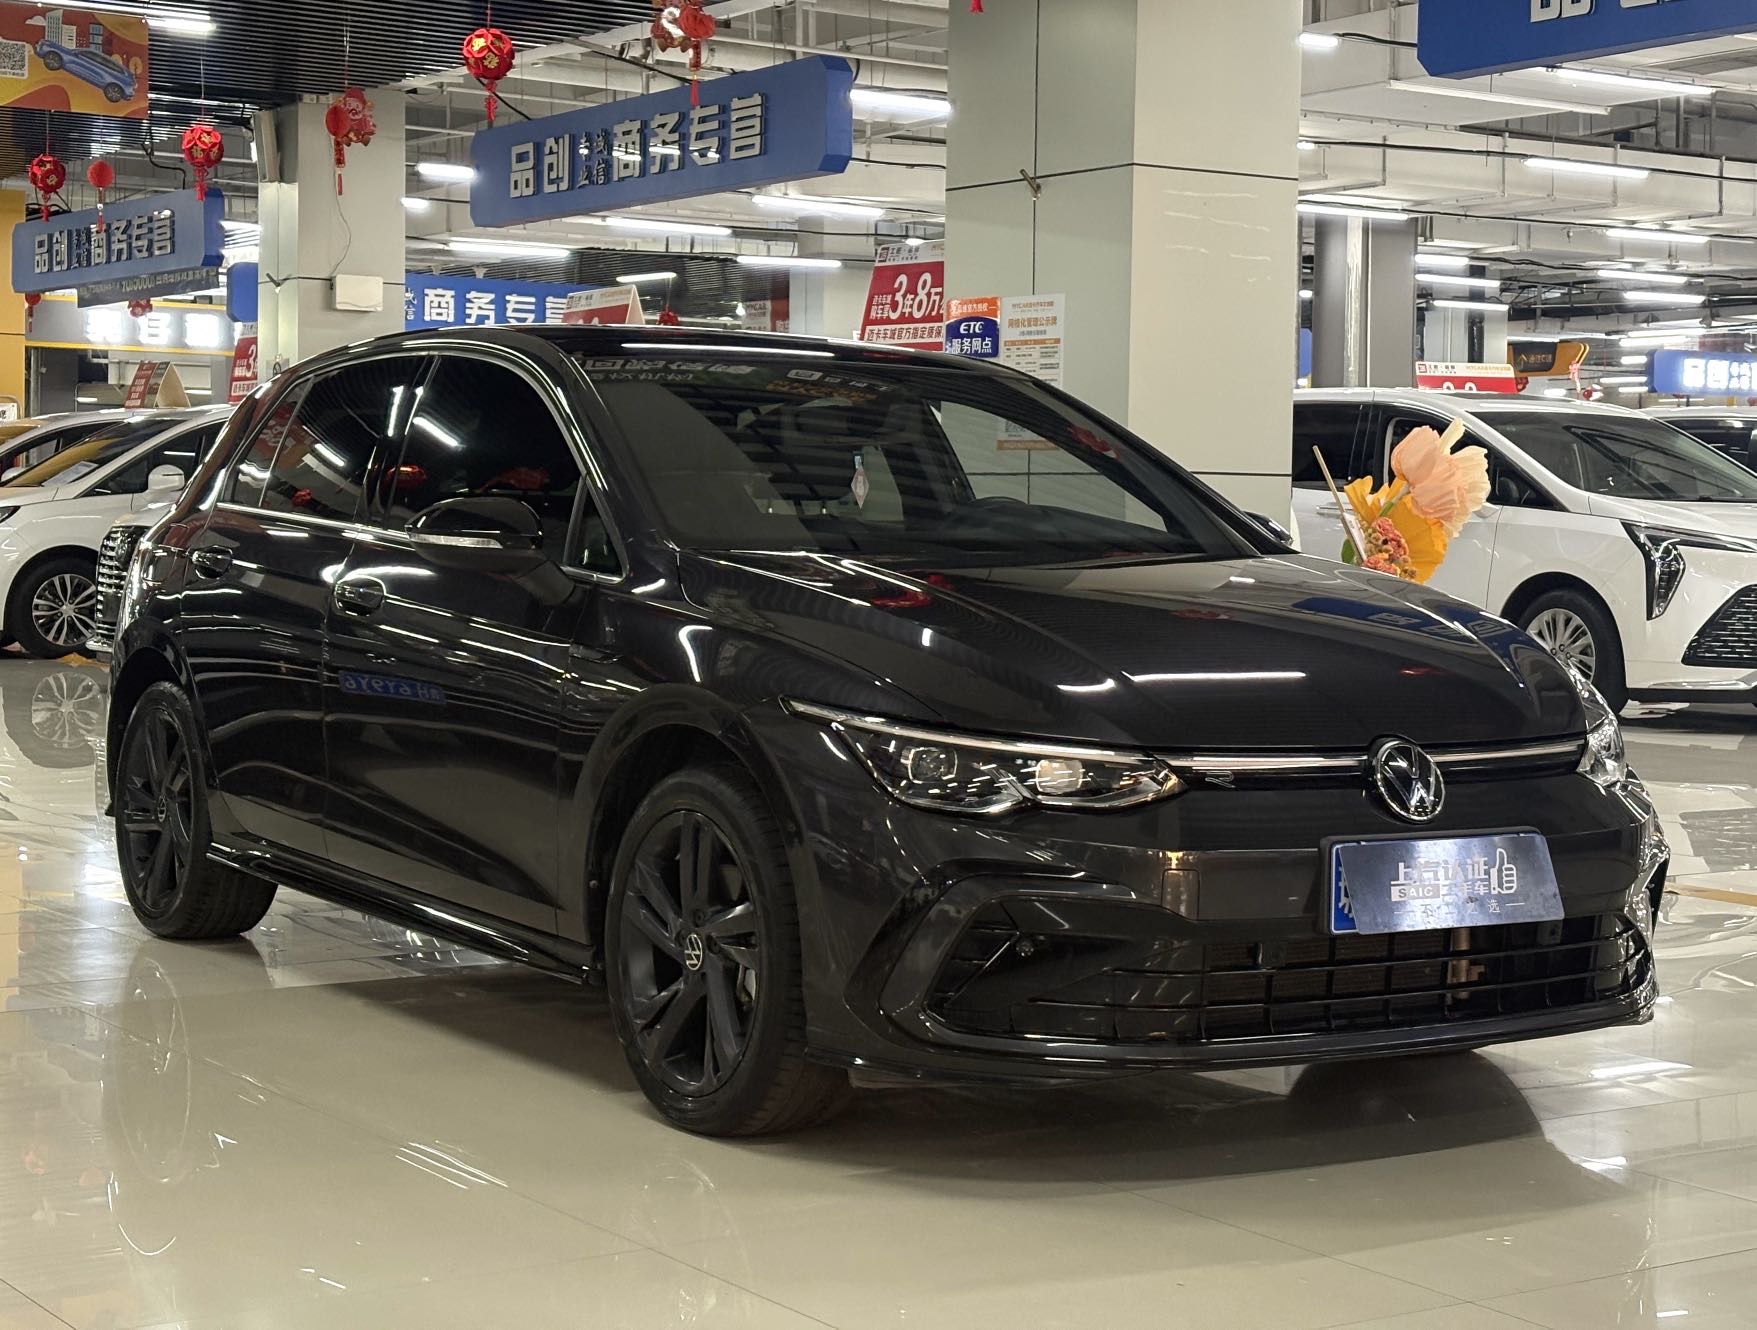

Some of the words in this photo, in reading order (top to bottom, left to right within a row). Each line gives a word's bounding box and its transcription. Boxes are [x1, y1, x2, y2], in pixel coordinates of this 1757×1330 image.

[510, 134, 573, 198] 品创
[612, 93, 764, 182] 商务专营
[34, 229, 68, 274] 品创
[90, 210, 174, 266] 商务专营
[960, 321, 985, 334] ETC
[951, 337, 993, 355] 服务网点
[1391, 856, 1489, 885] 上汽认证
[1398, 886, 1434, 899] SAIC
